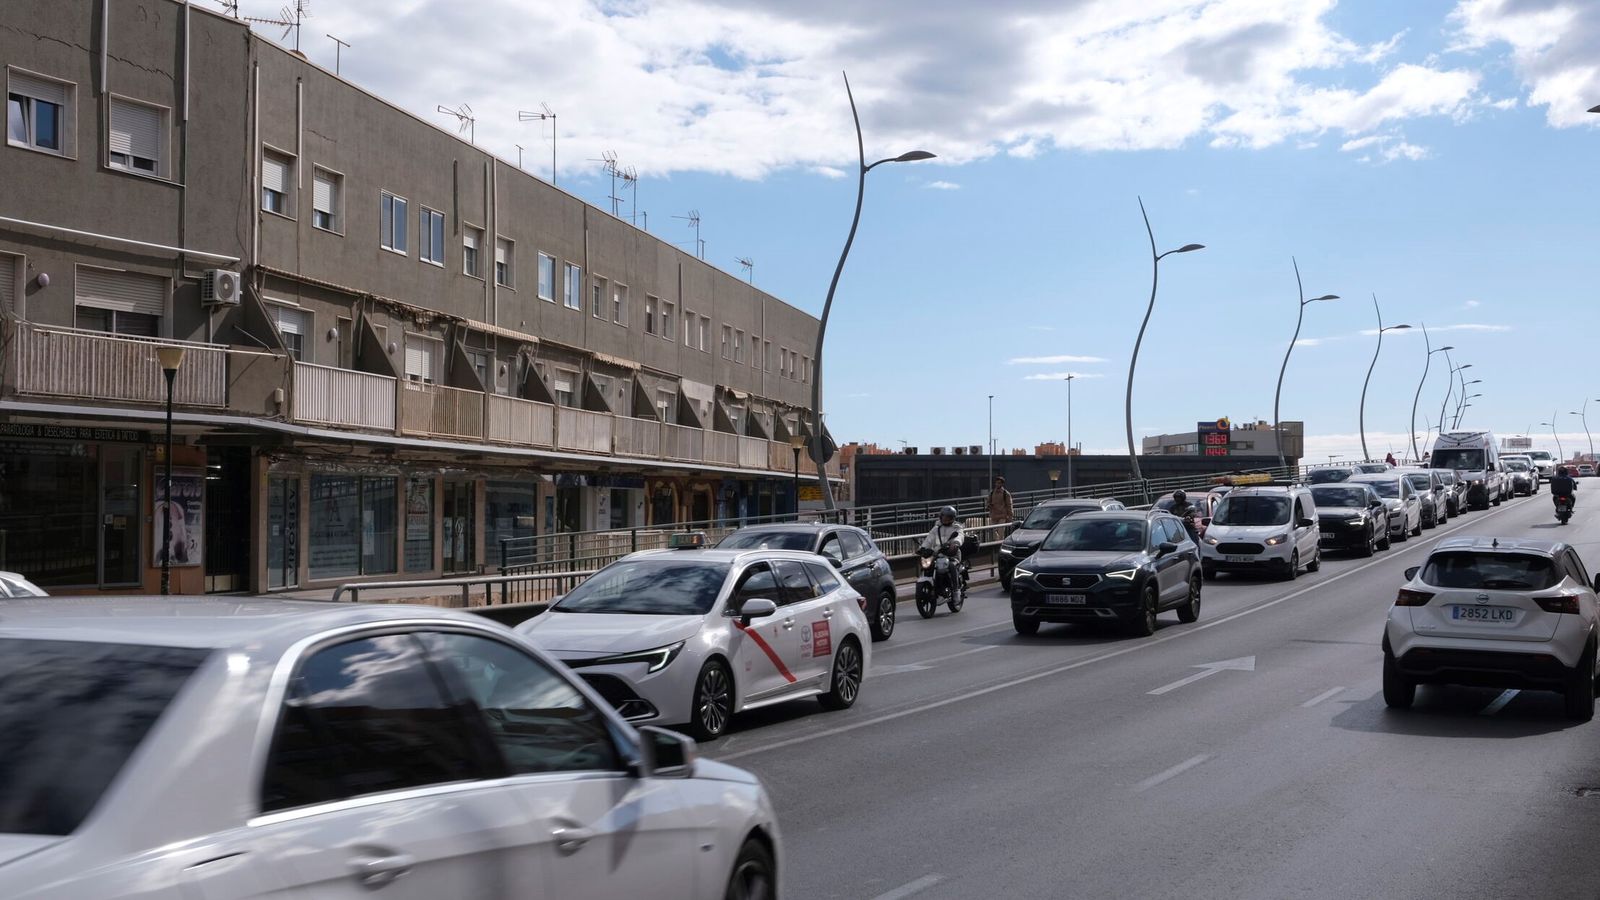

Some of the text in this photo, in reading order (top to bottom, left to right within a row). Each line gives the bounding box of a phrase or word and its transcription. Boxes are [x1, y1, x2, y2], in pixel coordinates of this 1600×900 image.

[79, 428, 91, 439] PARA
[288, 488, 296, 575] ASESORIA
[1460, 608, 1512, 620] 2852 LKD
